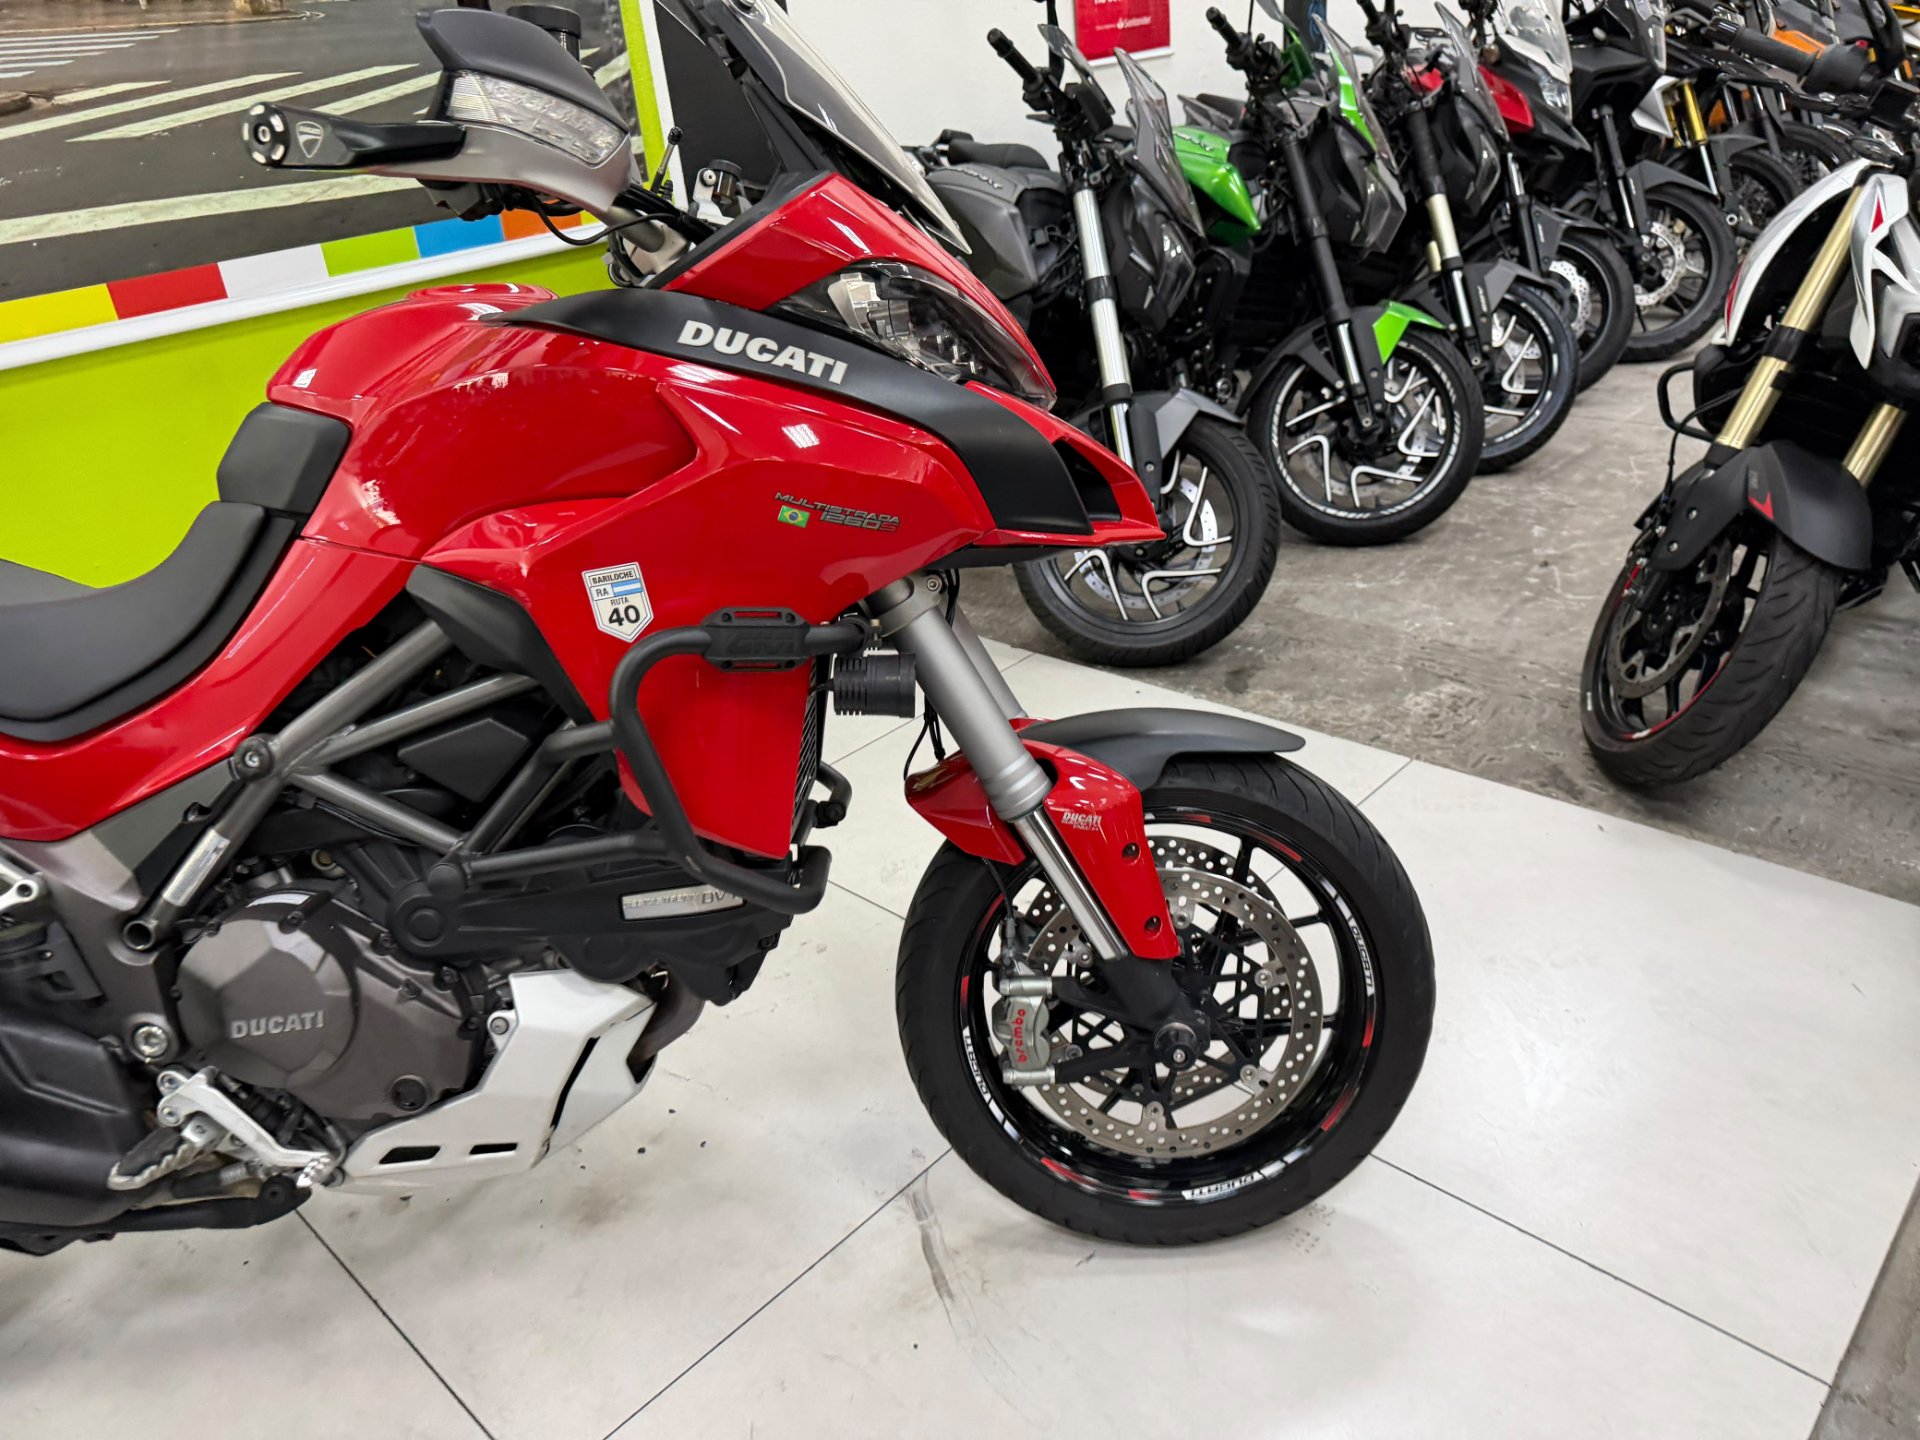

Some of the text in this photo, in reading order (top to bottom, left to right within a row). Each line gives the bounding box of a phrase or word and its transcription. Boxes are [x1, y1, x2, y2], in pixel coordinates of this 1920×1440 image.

[677, 319, 848, 385] DUCATI
[774, 491, 900, 523] MULTISTRADA
[592, 570, 634, 585] BARILOCHE
[595, 587, 609, 597] RA
[610, 597, 629, 606] RUTA
[608, 604, 640, 626] 40
[230, 1010, 325, 1039] DUCATI
[1012, 1008, 1028, 1063] brembo
